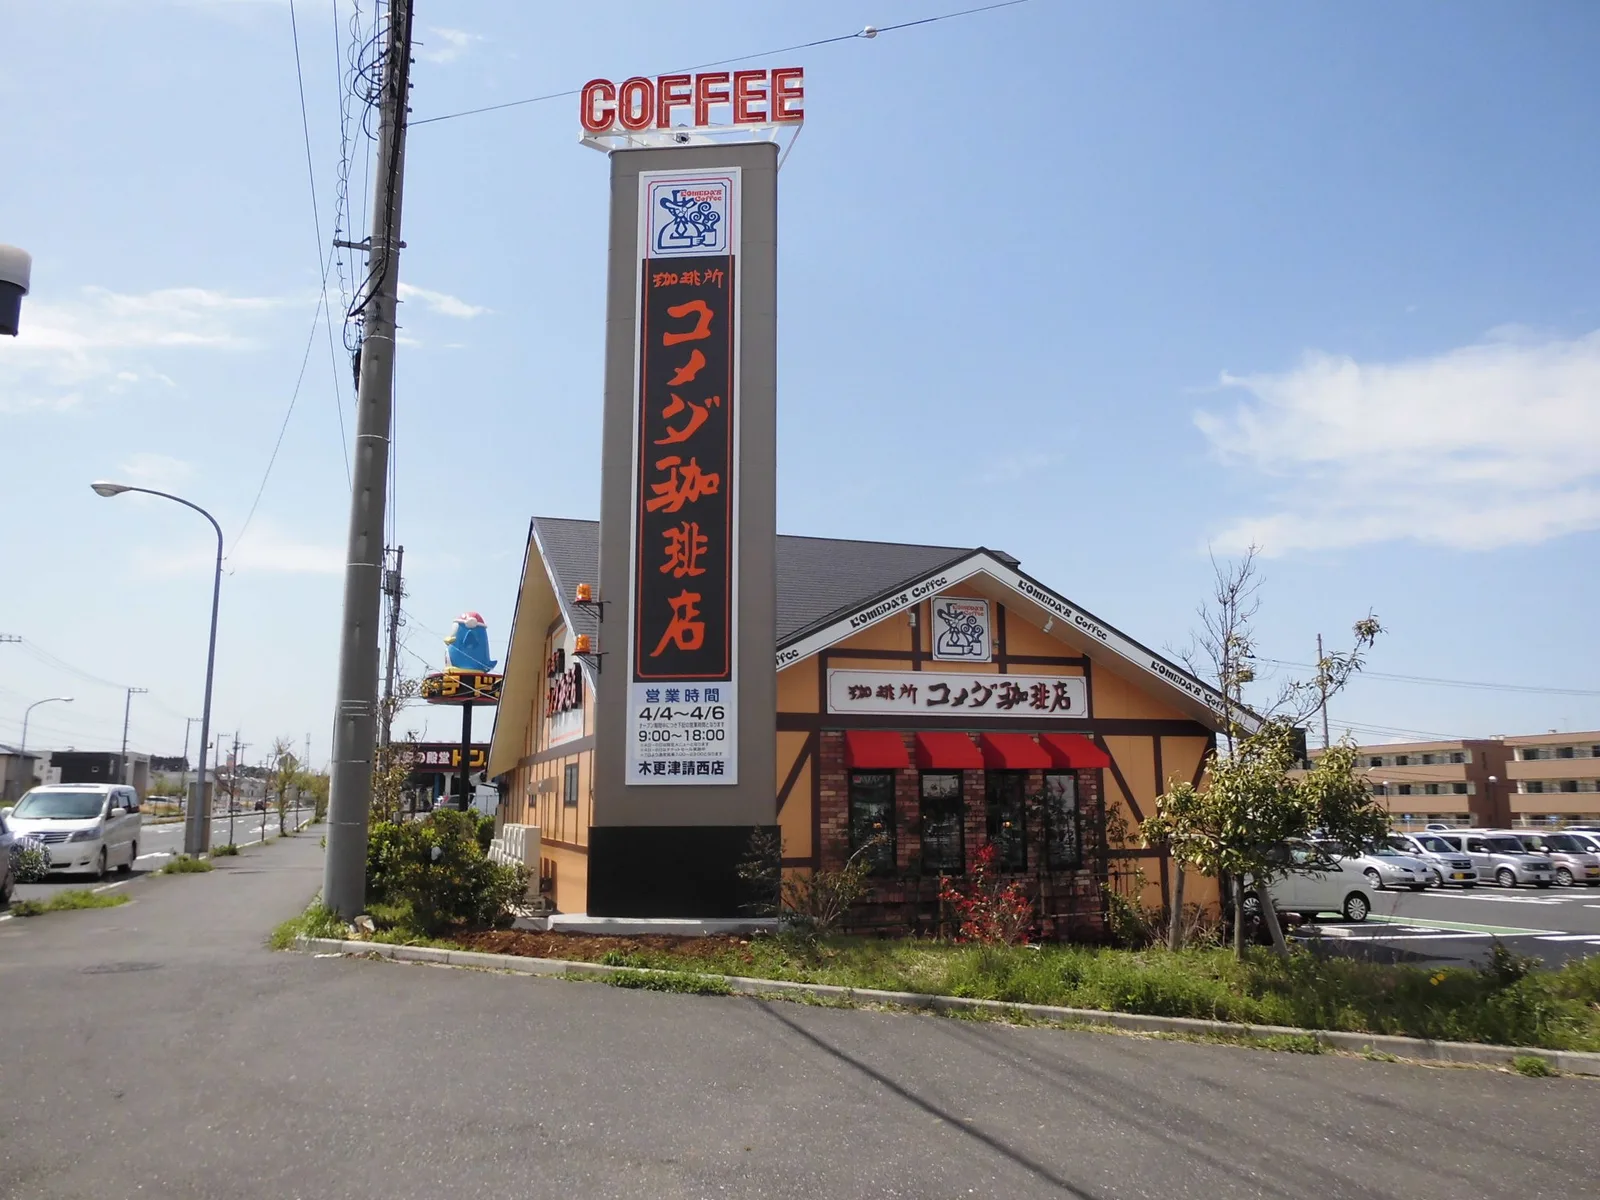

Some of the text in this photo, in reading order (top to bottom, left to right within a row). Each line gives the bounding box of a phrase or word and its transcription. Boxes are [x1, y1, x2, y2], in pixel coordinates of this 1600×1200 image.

[580, 67, 804, 133] COFFEE
[694, 195, 722, 203] Coffee
[653, 268, 724, 289] 珈琲所
[645, 299, 721, 658] コメダ珈琲店
[850, 576, 947, 629] KOMEDA'S Coffee
[1018, 579, 1107, 641] KOMEDA'S Coffee
[776, 649, 799, 666] ffee
[1150, 660, 1202, 697] KOMEDA'S
[645, 688, 720, 703] 営業時間
[848, 680, 1071, 712] 珈琲所 コメダ珈琲店
[638, 760, 725, 776] 木更津請西店
